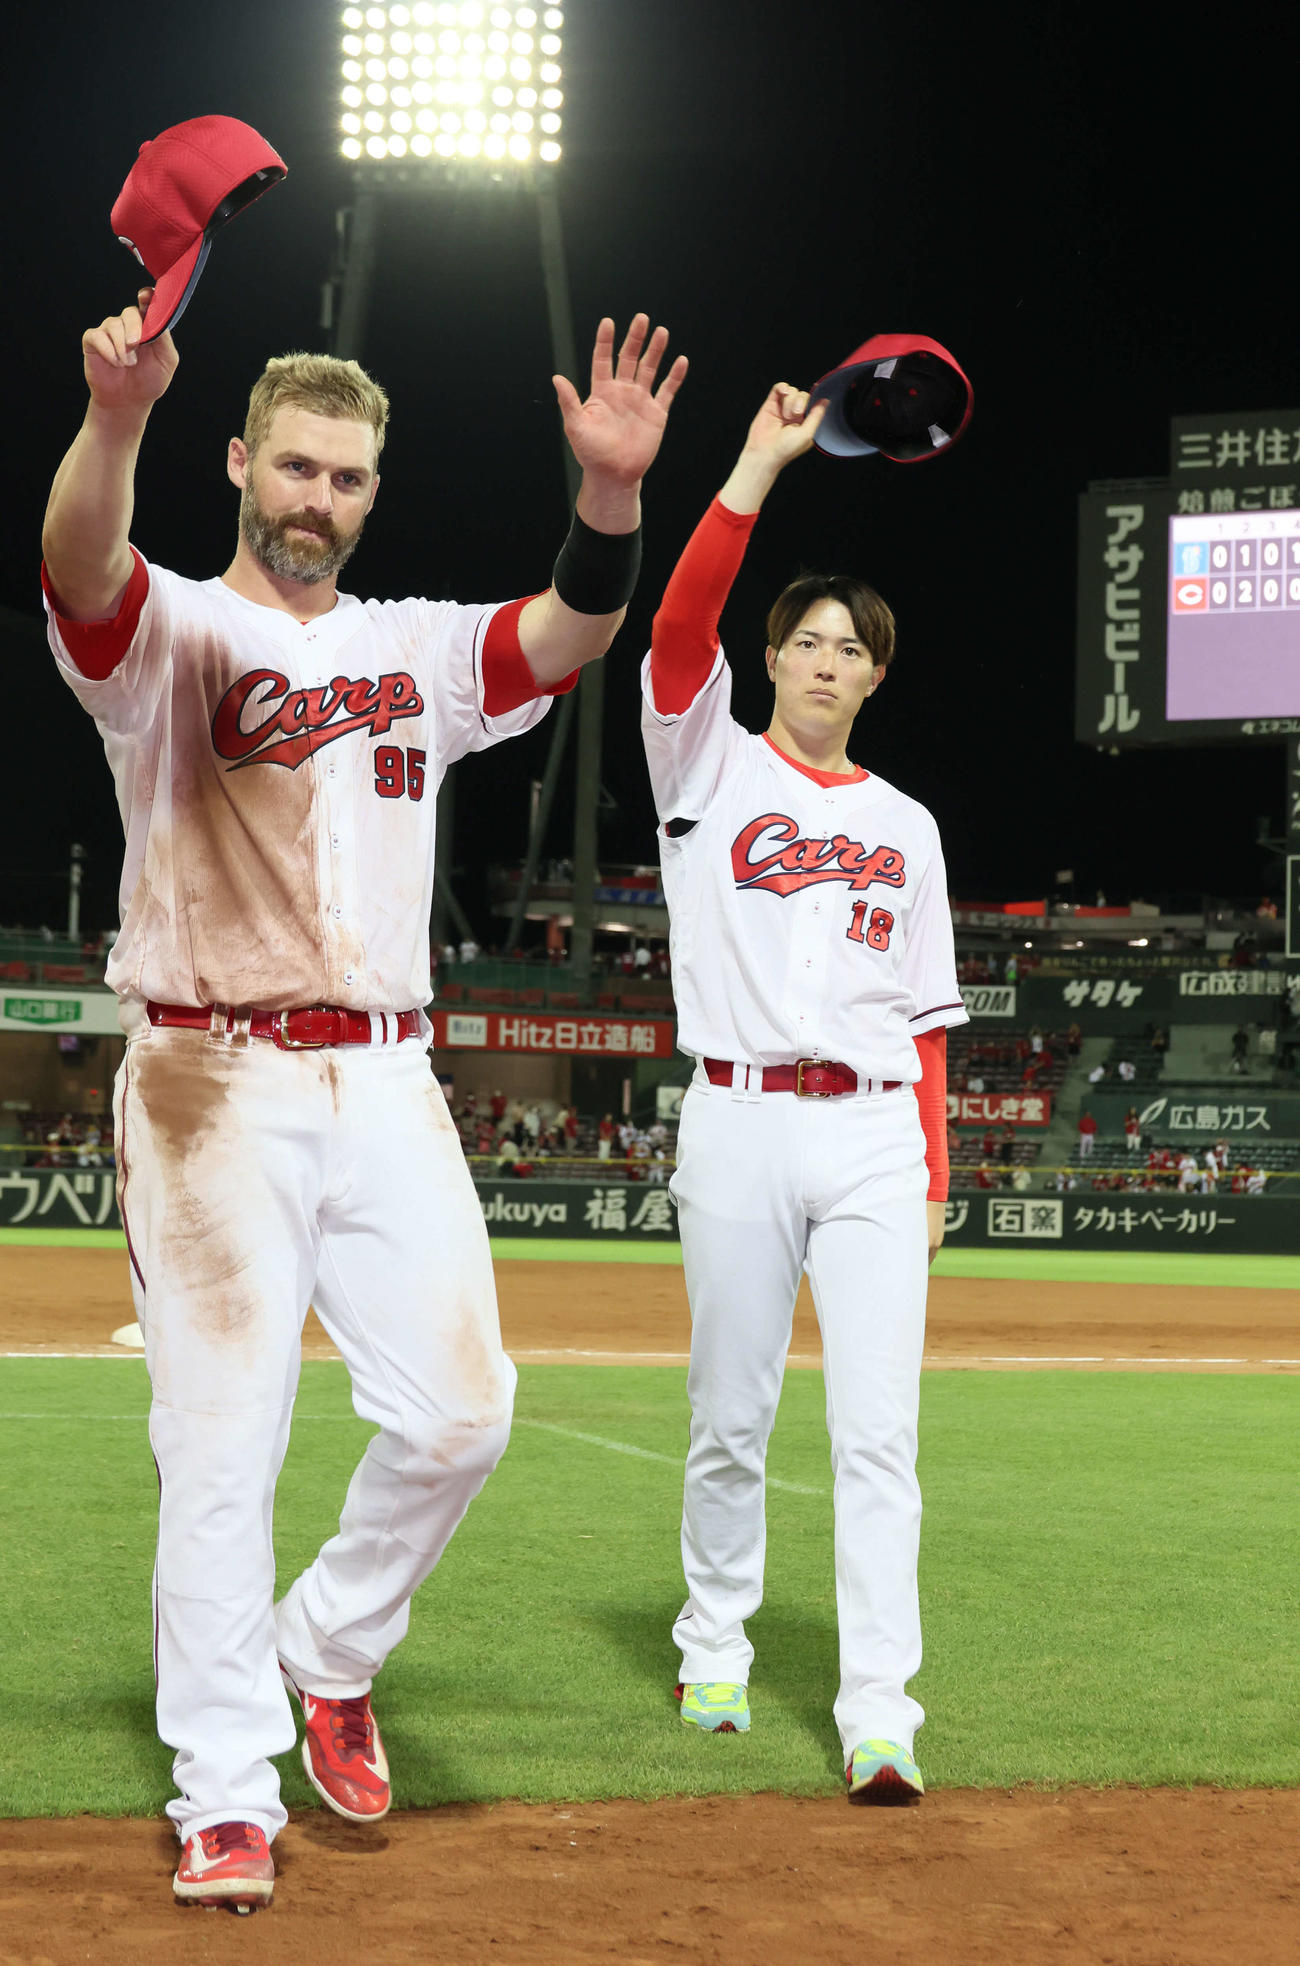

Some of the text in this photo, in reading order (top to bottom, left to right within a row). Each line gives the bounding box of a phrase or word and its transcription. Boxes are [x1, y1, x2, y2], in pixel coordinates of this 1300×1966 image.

[1178, 428, 1300, 468] 三井住
[1213, 545, 1228, 568] 0
[1240, 544, 1250, 567] 1
[1264, 542, 1279, 566] 0
[1212, 581, 1227, 604] 0
[1238, 580, 1252, 603] 2
[1263, 579, 1278, 602] 0
[1098, 505, 1144, 733] アサヒビール
[211, 668, 424, 772] Carp
[374, 745, 426, 802] 95
[731, 812, 906, 899] Carp
[846, 899, 895, 952] 18
[1063, 980, 1143, 1008] サタケ
[499, 1018, 656, 1053] Hitz日立造船
[1169, 1105, 1271, 1131] 広島ガス
[584, 1188, 674, 1232] 福屋
